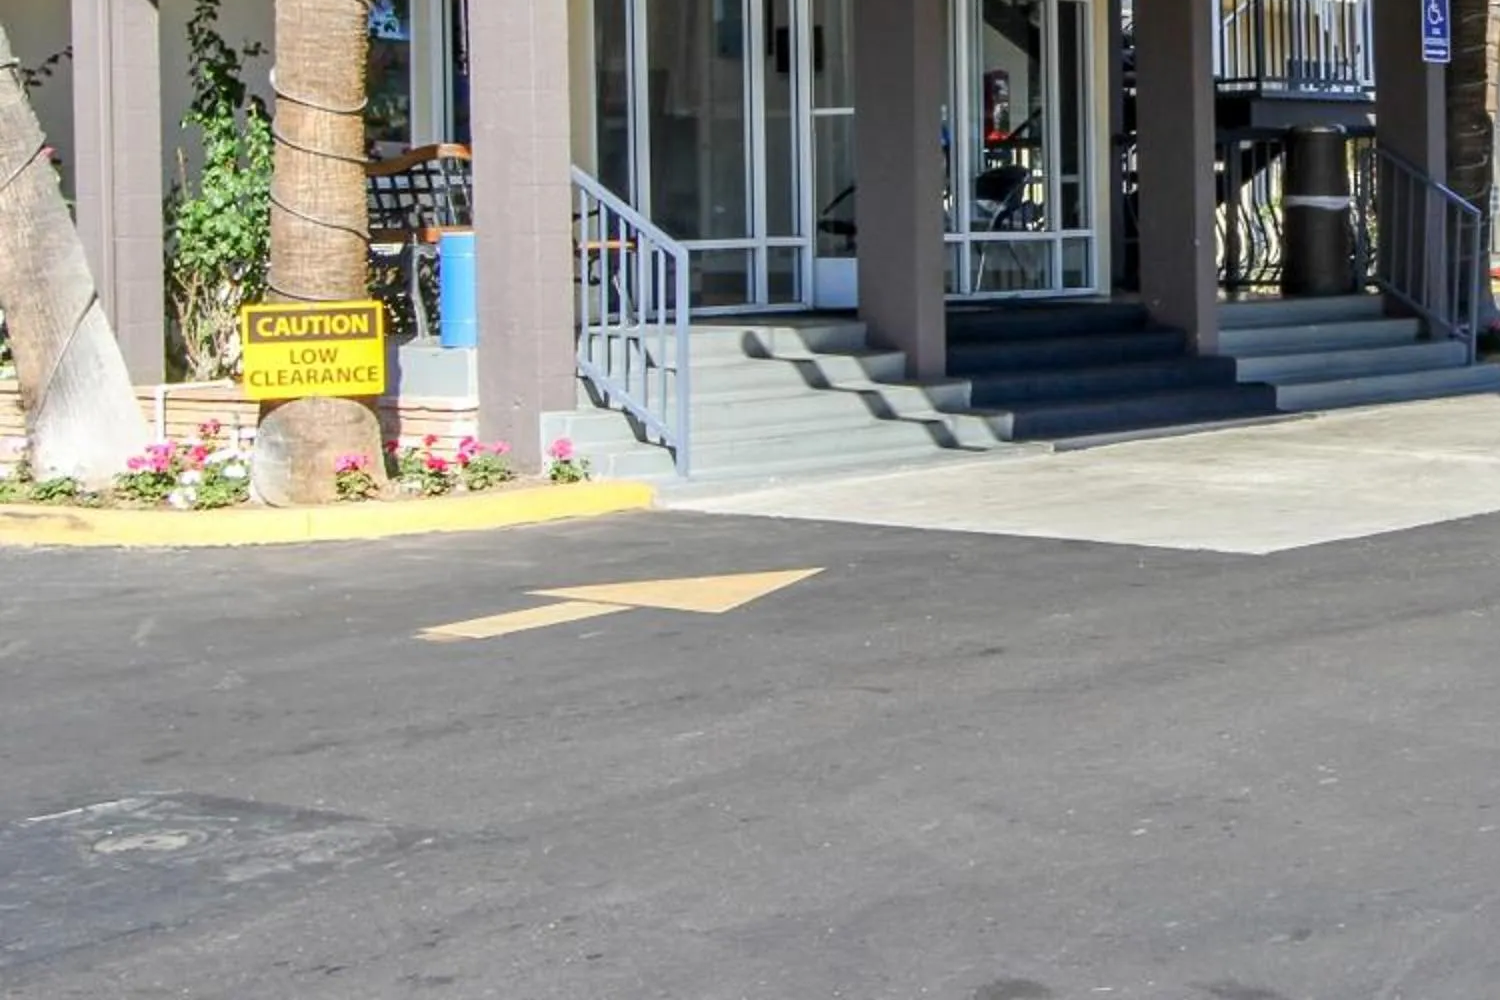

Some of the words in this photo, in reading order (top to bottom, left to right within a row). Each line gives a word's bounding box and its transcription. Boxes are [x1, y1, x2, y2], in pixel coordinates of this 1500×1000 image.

[255, 313, 369, 338] CAUTION
[289, 347, 339, 366] LOW
[249, 365, 380, 388] CLEARANCE
